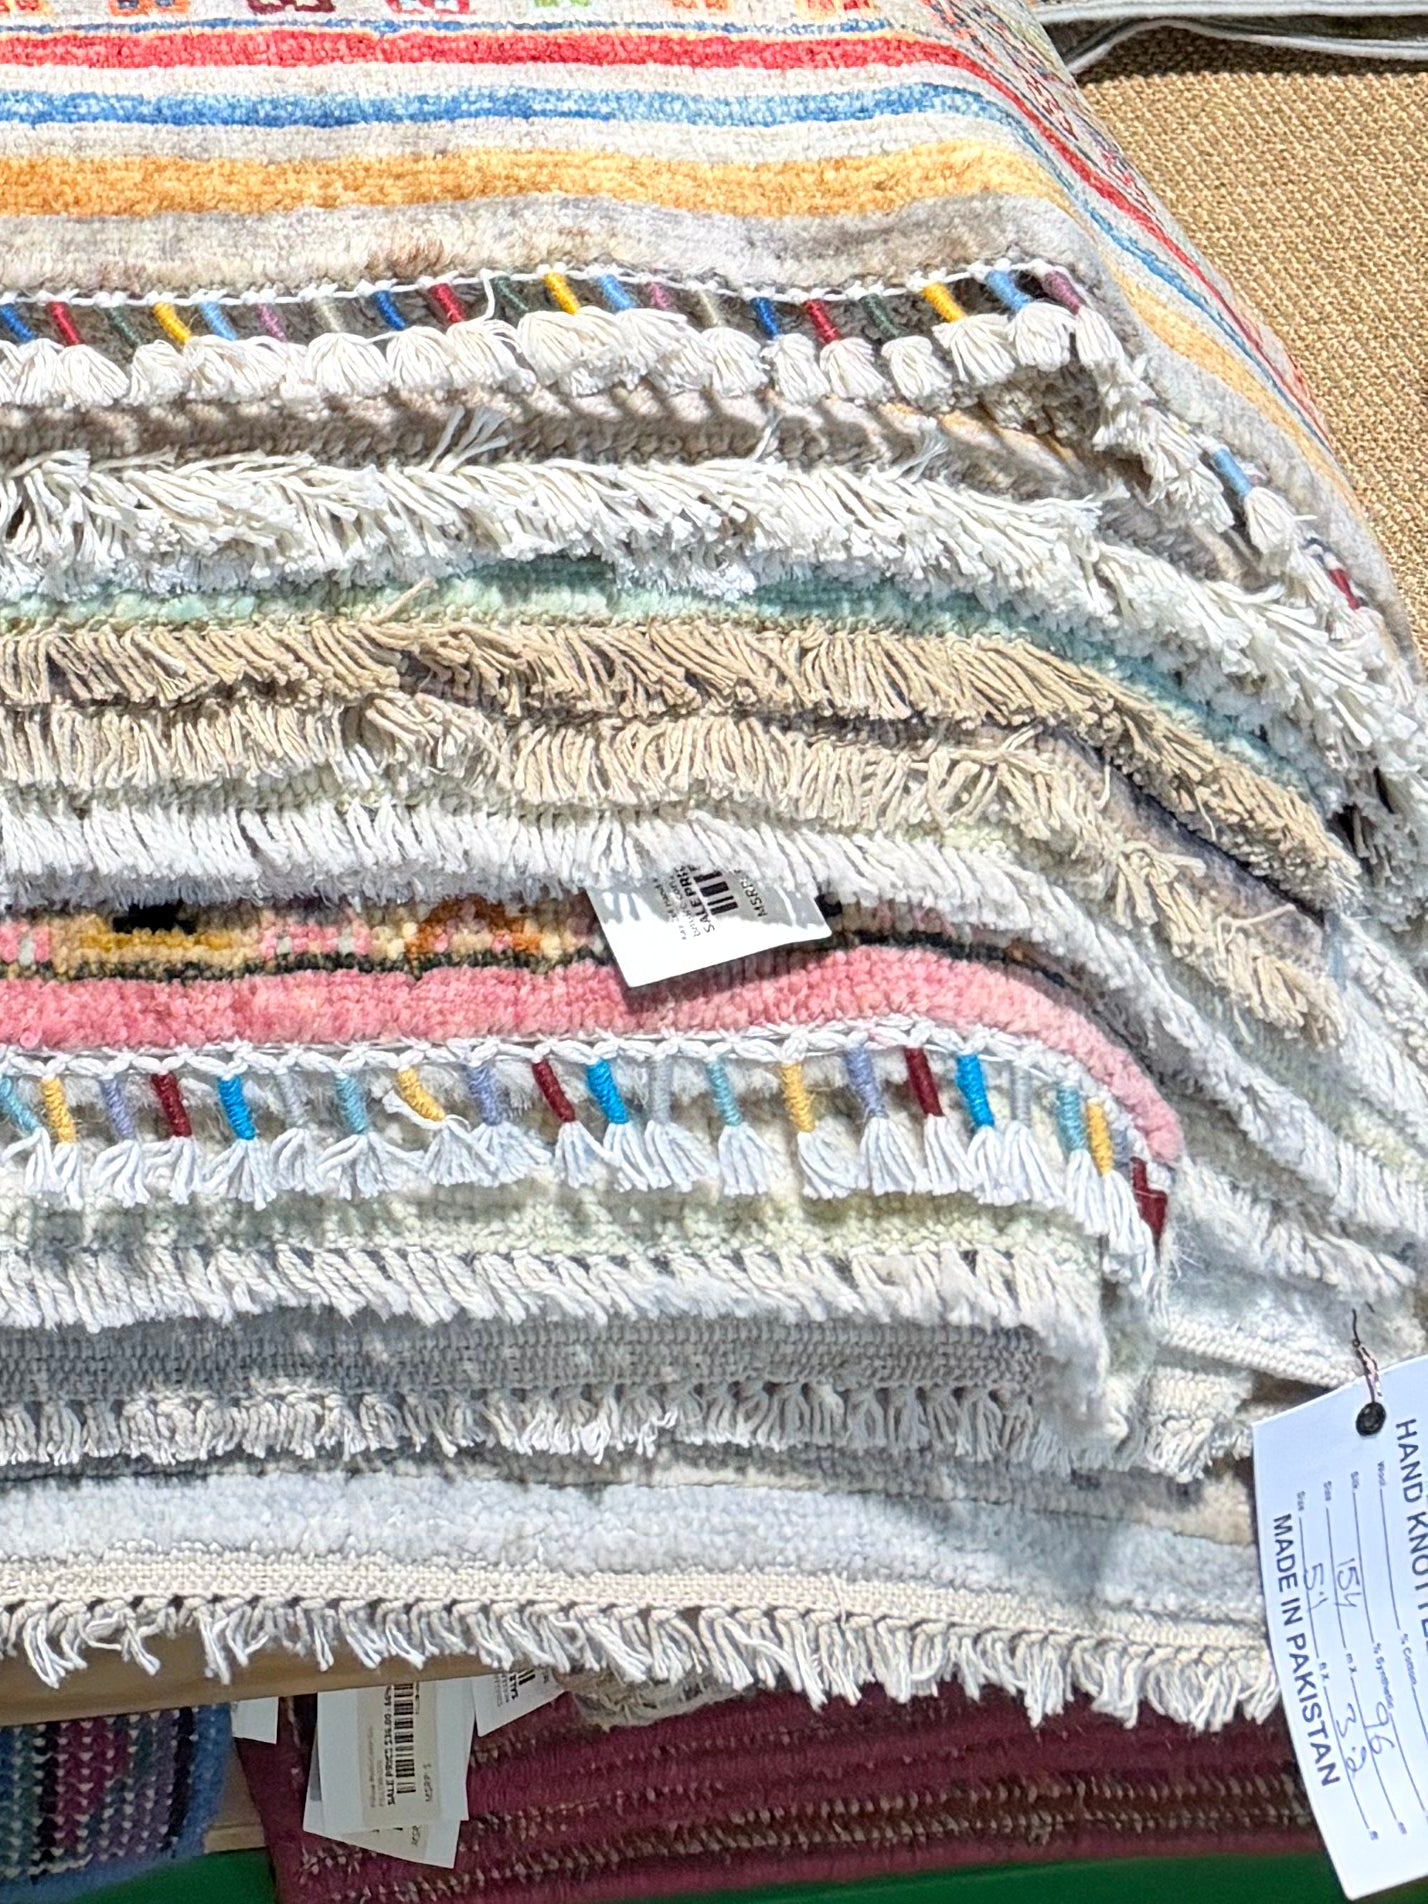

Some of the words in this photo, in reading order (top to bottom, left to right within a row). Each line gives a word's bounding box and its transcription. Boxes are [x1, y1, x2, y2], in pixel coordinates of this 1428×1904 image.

[690, 898, 715, 933] SALE
[1396, 1418, 1423, 1503] HAND
[1273, 1513, 1298, 1593] MADE
[1334, 1557, 1362, 1607] 154
[1280, 1597, 1303, 1626] IN
[1286, 1632, 1341, 1786] PAKISTAN
[1364, 1701, 1395, 1755] 96
[387, 1780, 395, 1805] SALE
